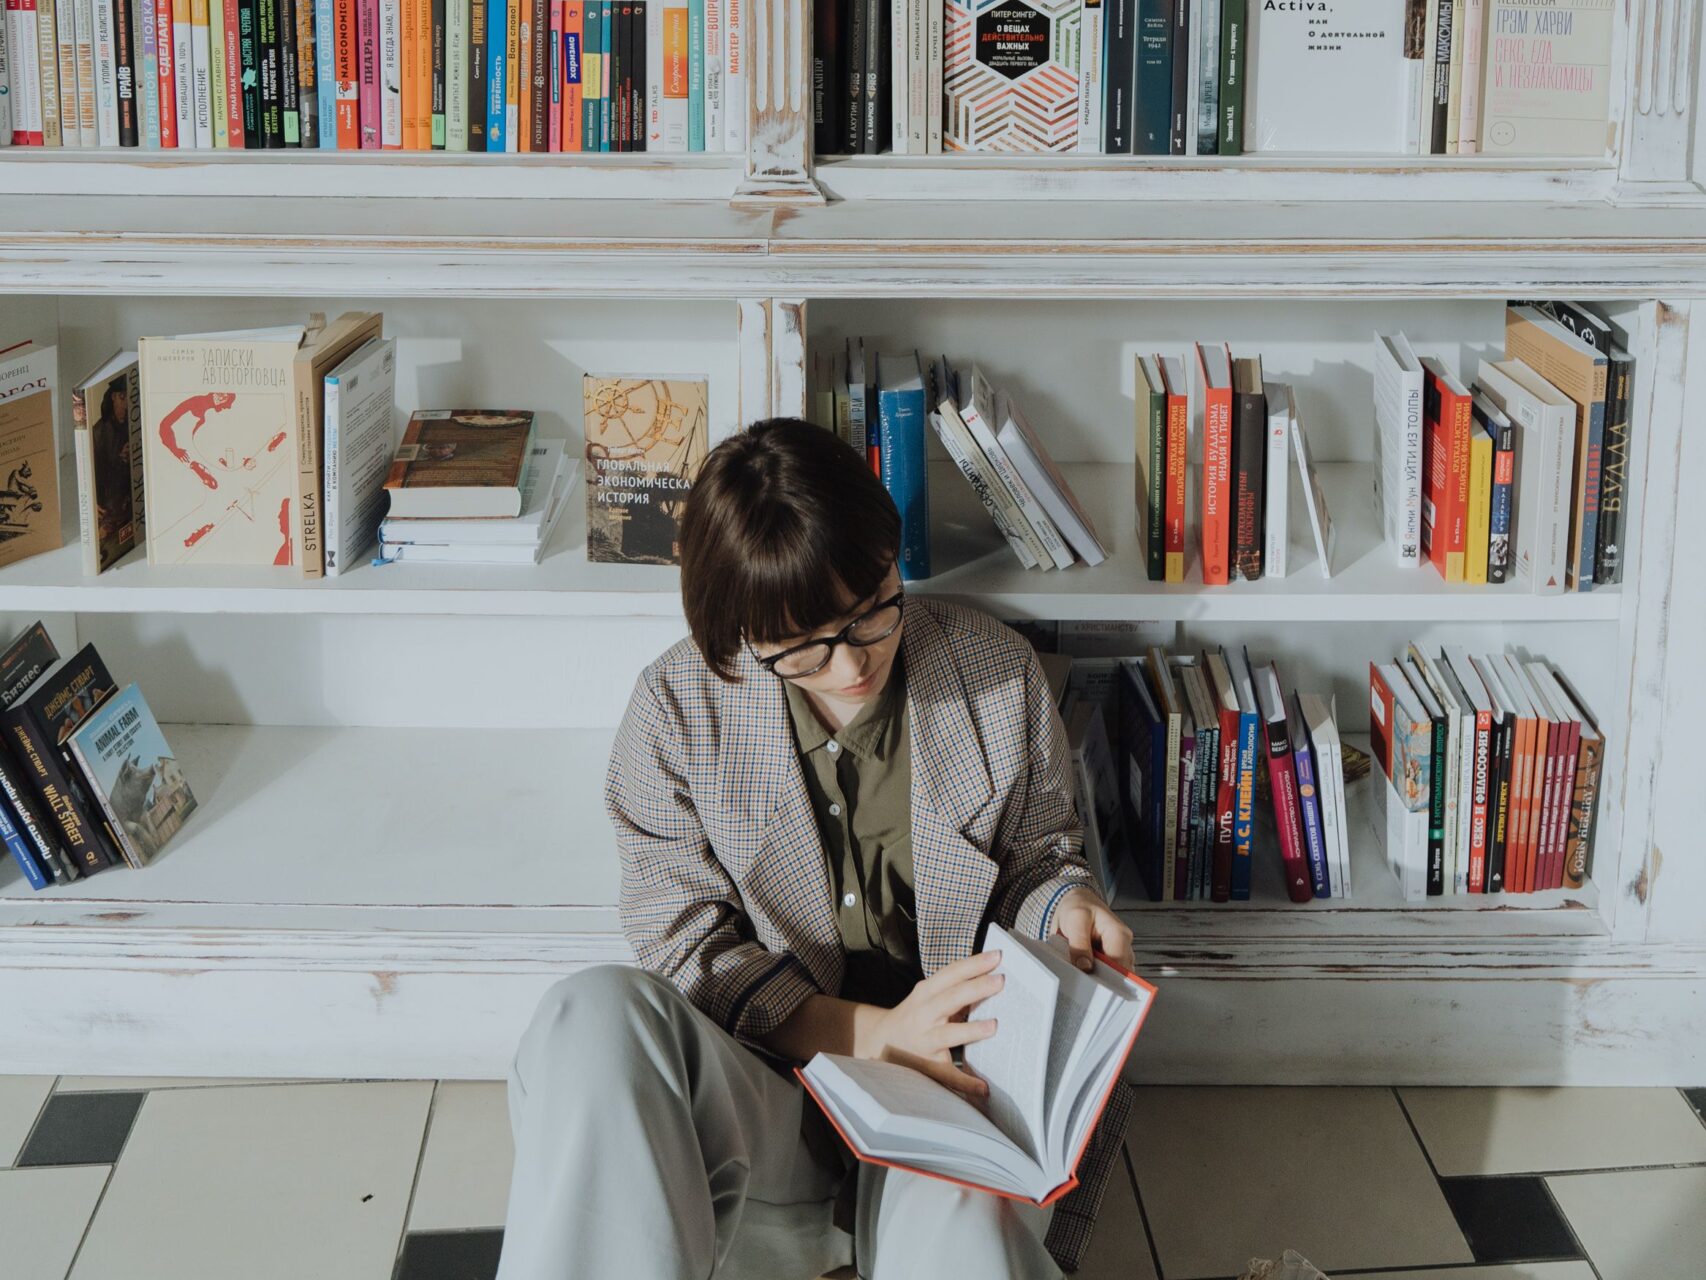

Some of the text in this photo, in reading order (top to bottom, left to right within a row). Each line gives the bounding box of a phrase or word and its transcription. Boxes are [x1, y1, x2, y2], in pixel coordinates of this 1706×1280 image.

[991, 10, 1037, 19] ПИТЕР СИНГЕР
[1264, 0, 1335, 13] Activa,
[1496, 9, 1573, 36] ГРЭМ ХАРВИ
[320, 14, 331, 61] ОДНОЙ
[996, 24, 1030, 34] О ВЕЩАХ
[1437, 2, 1453, 63] МАКСИМЫ
[228, 30, 237, 77] МИЛЛИОНЕР
[386, 36, 394, 62] ВСЕГДА
[568, 36, 578, 79] харизма
[730, 32, 738, 74] МАСТЕР
[996, 42, 1030, 51] ВАЖНЫХ
[40, 14, 56, 119] РЕЖИМ ГЕНИЯ
[180, 63, 187, 73] НА
[321, 63, 332, 81] НА
[1494, 64, 1594, 94] И НЕЗНАКОМЦЫ
[146, 71, 157, 139] ВЗРЫВНОЙ
[181, 75, 189, 120] МОТИВАЦИЯ
[197, 67, 208, 128] ИСПОЛНЕНИЕ
[230, 93, 238, 119] ДУМАЙ
[201, 348, 255, 367] ЗАПИСКИ
[202, 367, 287, 387] АВТОТОРГОВЦА
[1407, 389, 1420, 429] ТОЛПЫ
[1219, 403, 1228, 481] ИНДИЯ И ТИБЕТ
[1406, 432, 1418, 448] ИЗ
[597, 458, 672, 474] ГЛОБАЛЬНАЯ
[1208, 403, 1219, 515] ИСТОРИЯ БУДДИЗМА
[1404, 450, 1417, 482] УЙТИ
[1602, 417, 1630, 514] БУДДА
[597, 492, 650, 505] ИСТОРИЯ
[304, 492, 317, 552] STRELKA
[1474, 730, 1489, 849] СЕКС И ФИЛОСОФИЯ
[43, 783, 85, 847] WALL STREET
[1219, 810, 1233, 844] ПУТЬ
